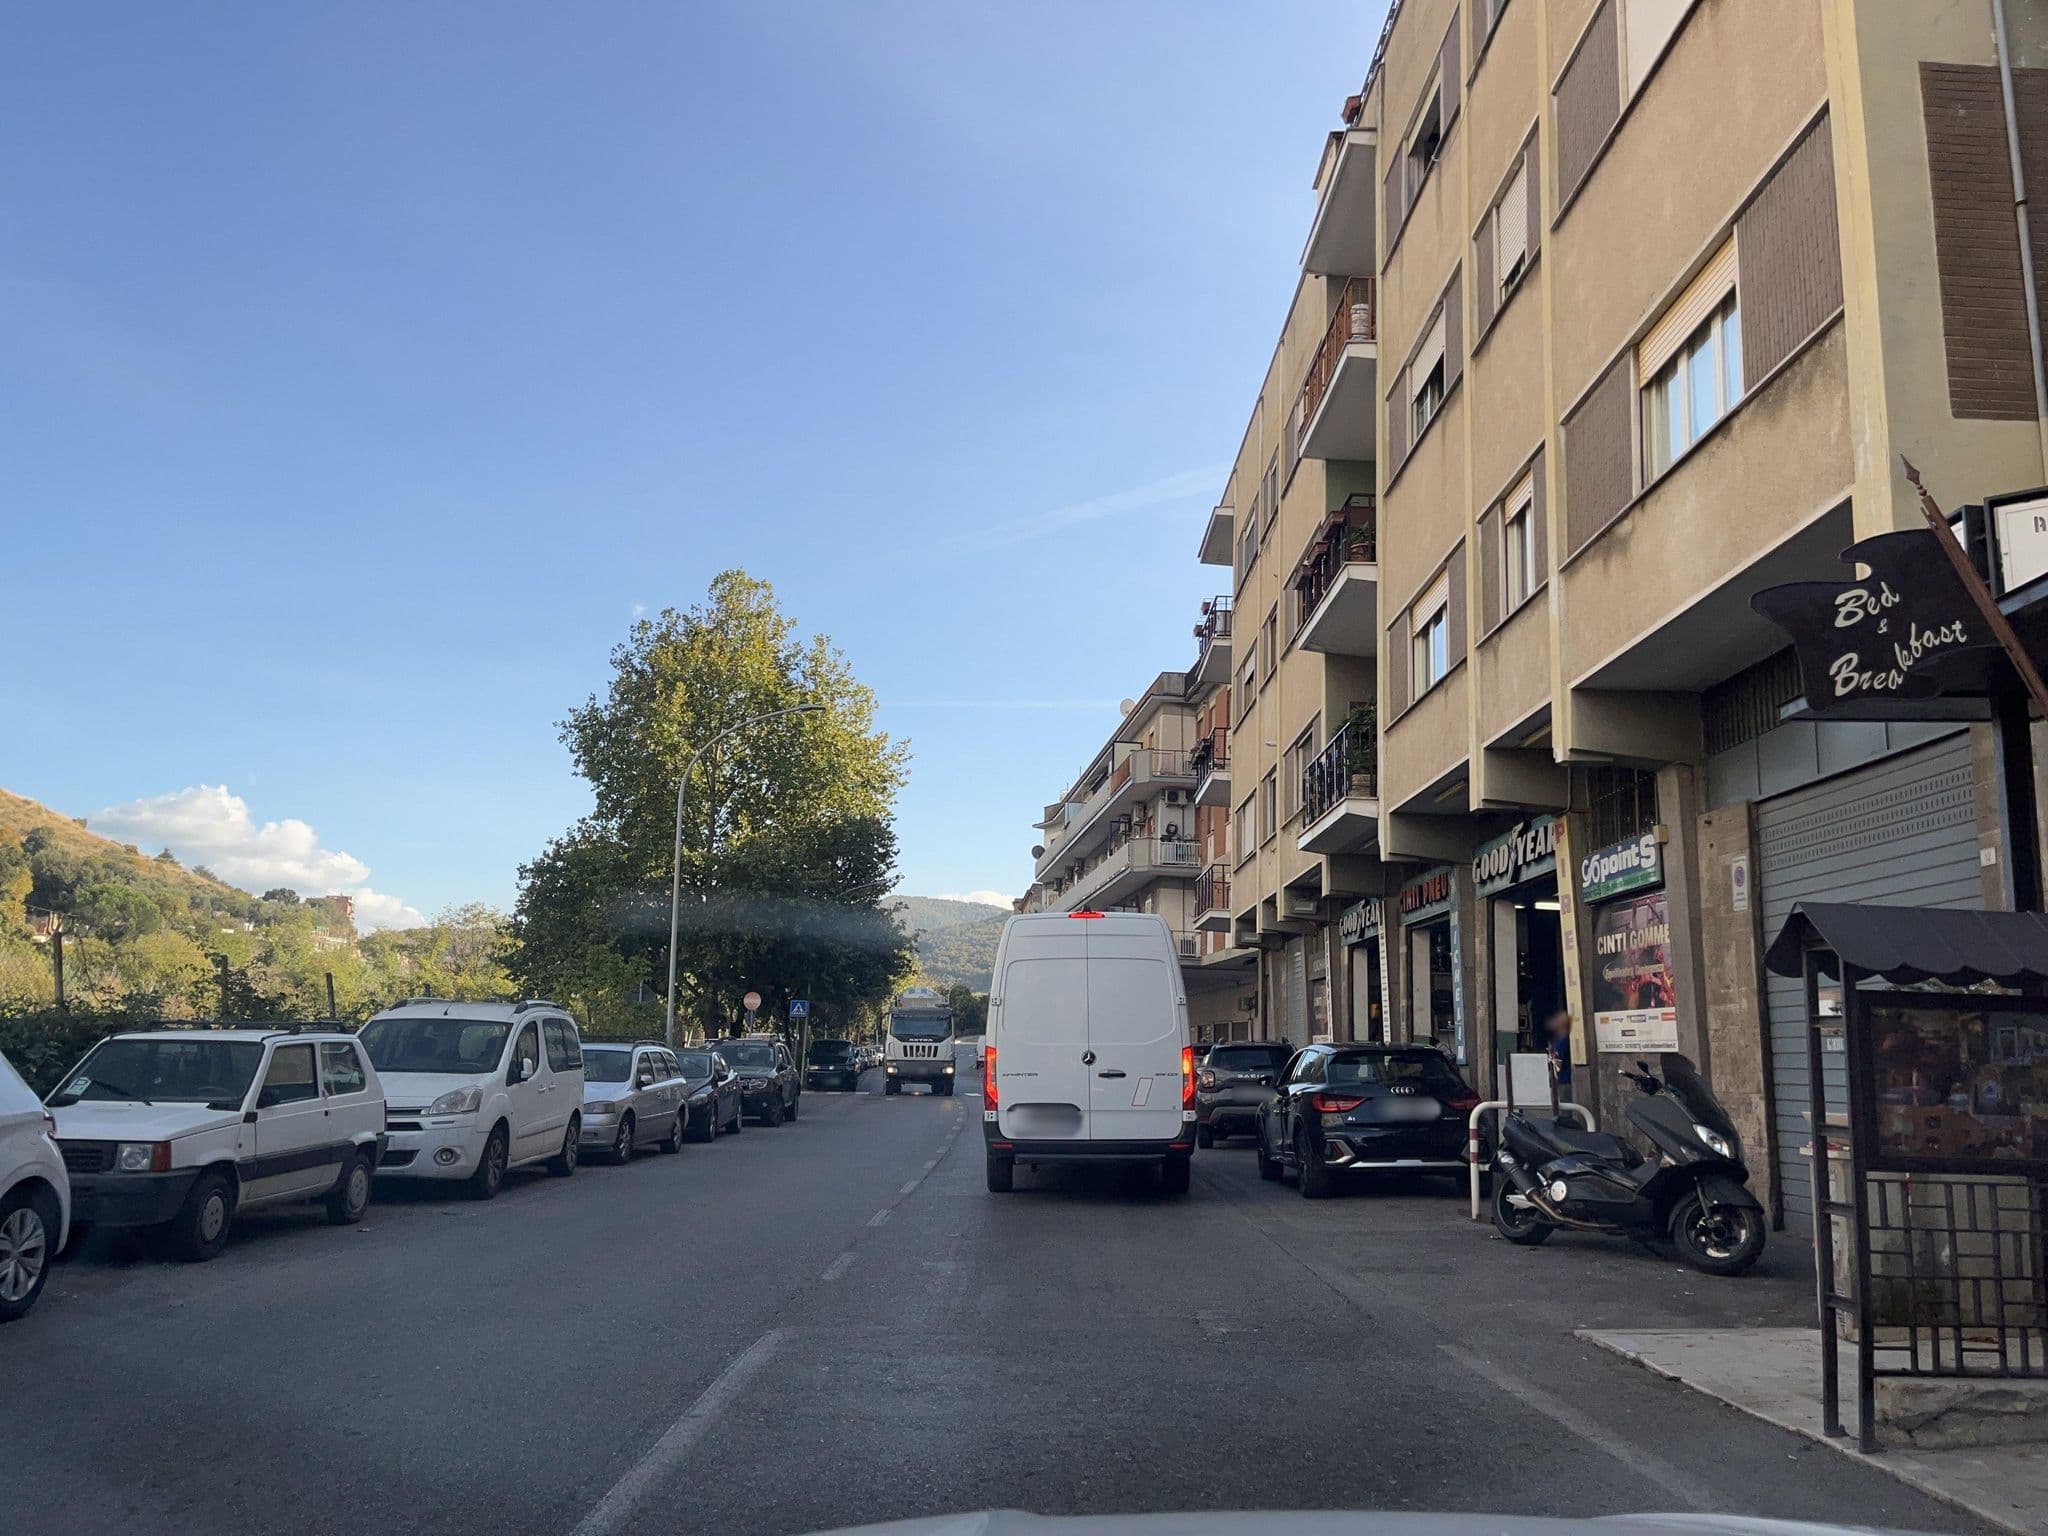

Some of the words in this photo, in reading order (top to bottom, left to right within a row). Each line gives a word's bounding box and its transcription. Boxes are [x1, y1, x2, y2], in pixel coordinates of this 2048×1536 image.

[1834, 581, 1900, 628] Bed
[1877, 618, 1888, 634] &
[1829, 620, 1967, 697] Breakfast
[1597, 932, 1627, 955] CINTI
[1630, 923, 1670, 950] GOMME
